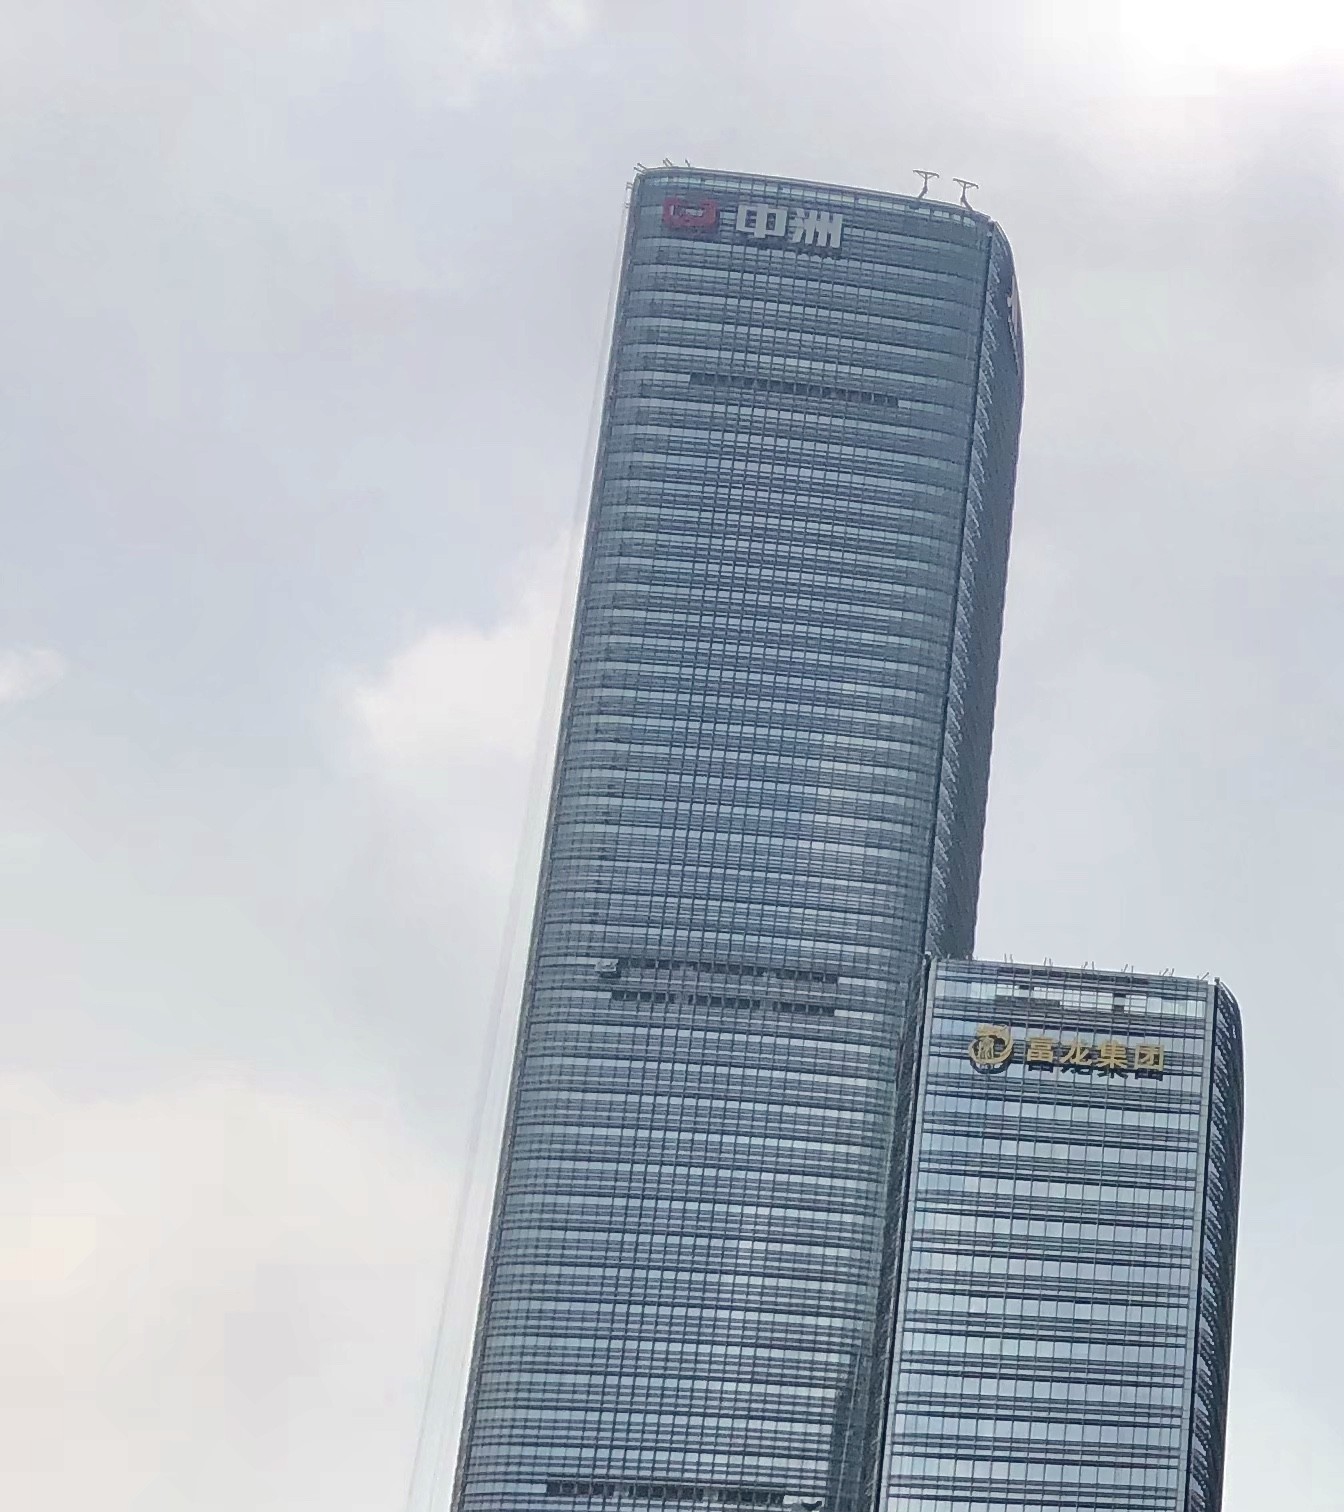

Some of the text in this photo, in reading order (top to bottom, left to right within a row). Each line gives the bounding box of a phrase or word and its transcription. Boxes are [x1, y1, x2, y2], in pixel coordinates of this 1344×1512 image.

[737, 204, 843, 248] 中洲
[1026, 1037, 1164, 1071] 富龙集团
